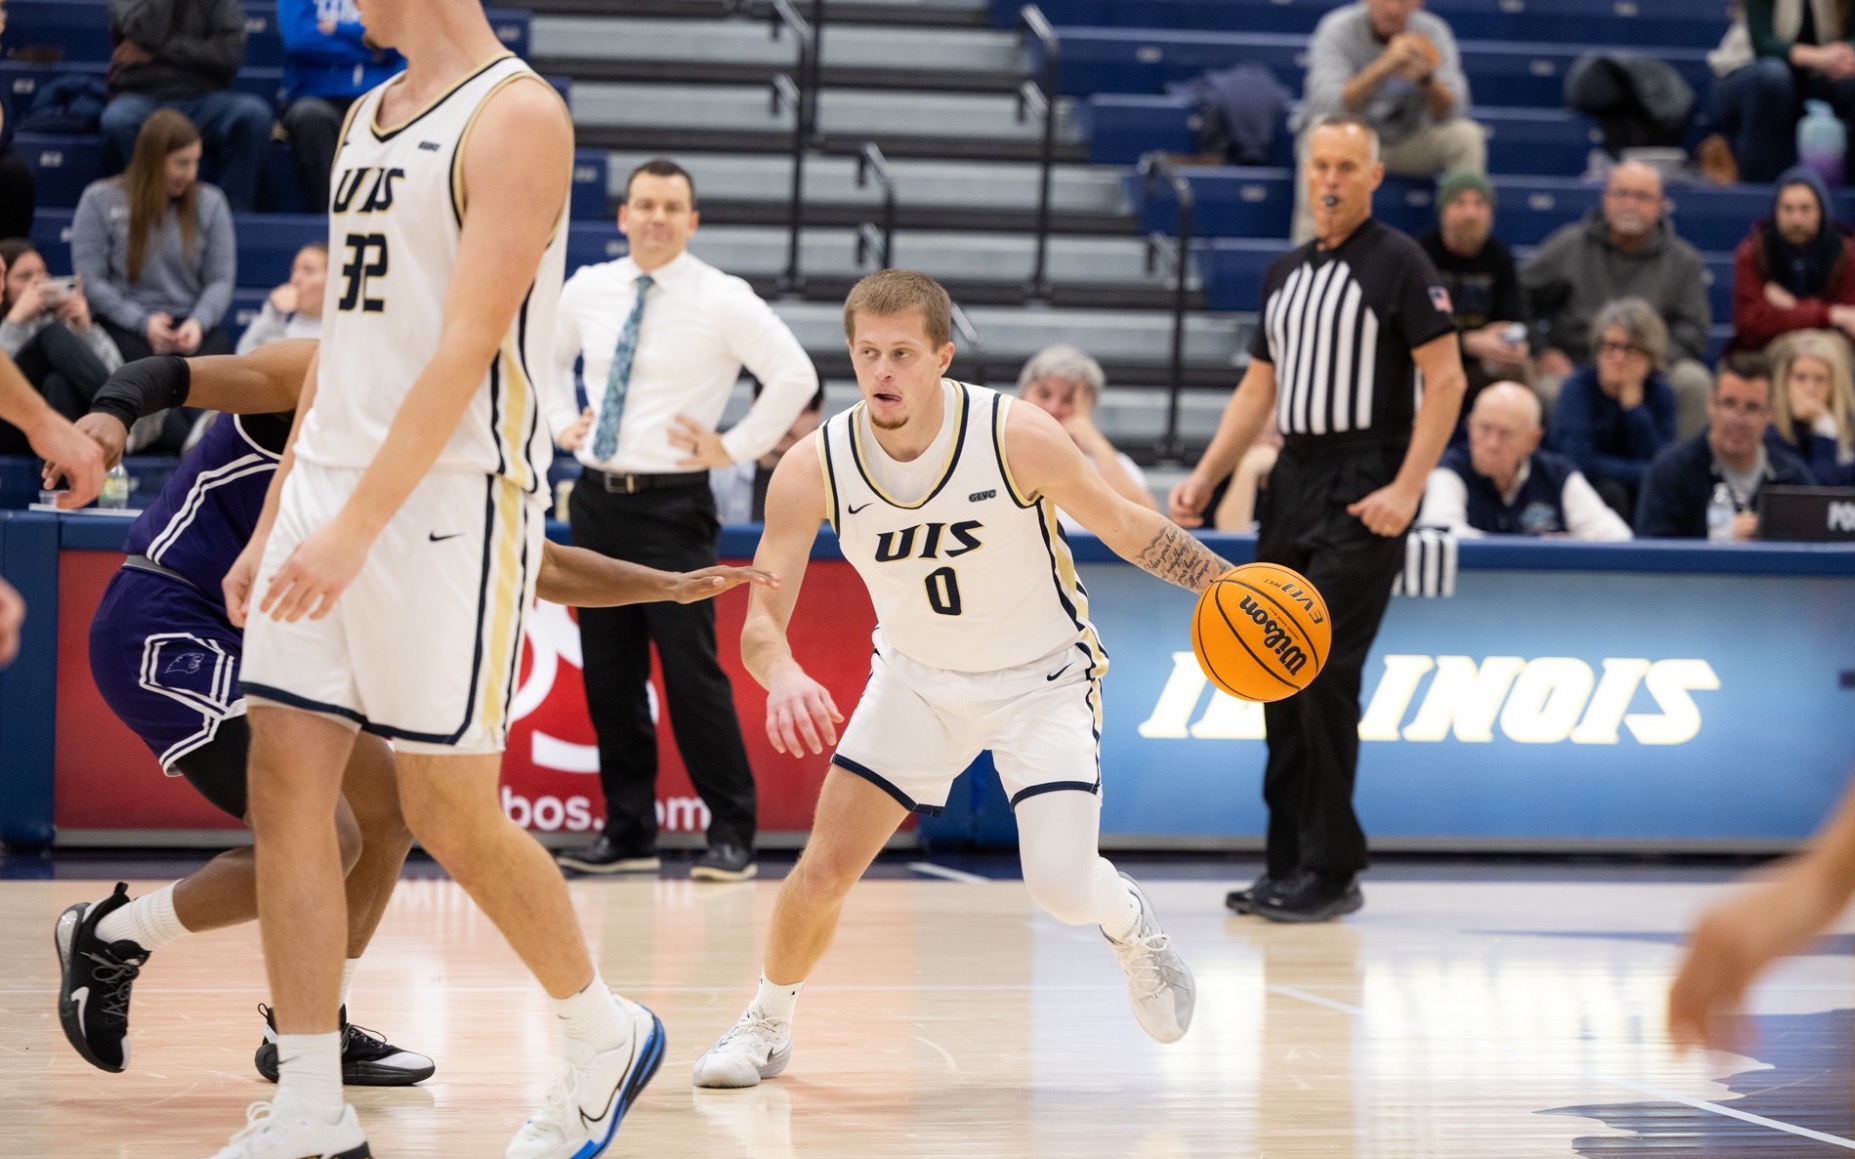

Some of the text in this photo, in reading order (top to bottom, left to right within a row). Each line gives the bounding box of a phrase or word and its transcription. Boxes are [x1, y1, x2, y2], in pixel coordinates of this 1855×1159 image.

[333, 167, 405, 213] UIS
[338, 233, 388, 312] 32
[968, 489, 997, 502] GLVC
[875, 520, 984, 562] UIS
[925, 566, 962, 616] 0
[1281, 583, 1324, 624] EVO
[1239, 594, 1307, 676] Wilson
[1137, 651, 1721, 745] ILINOIS
